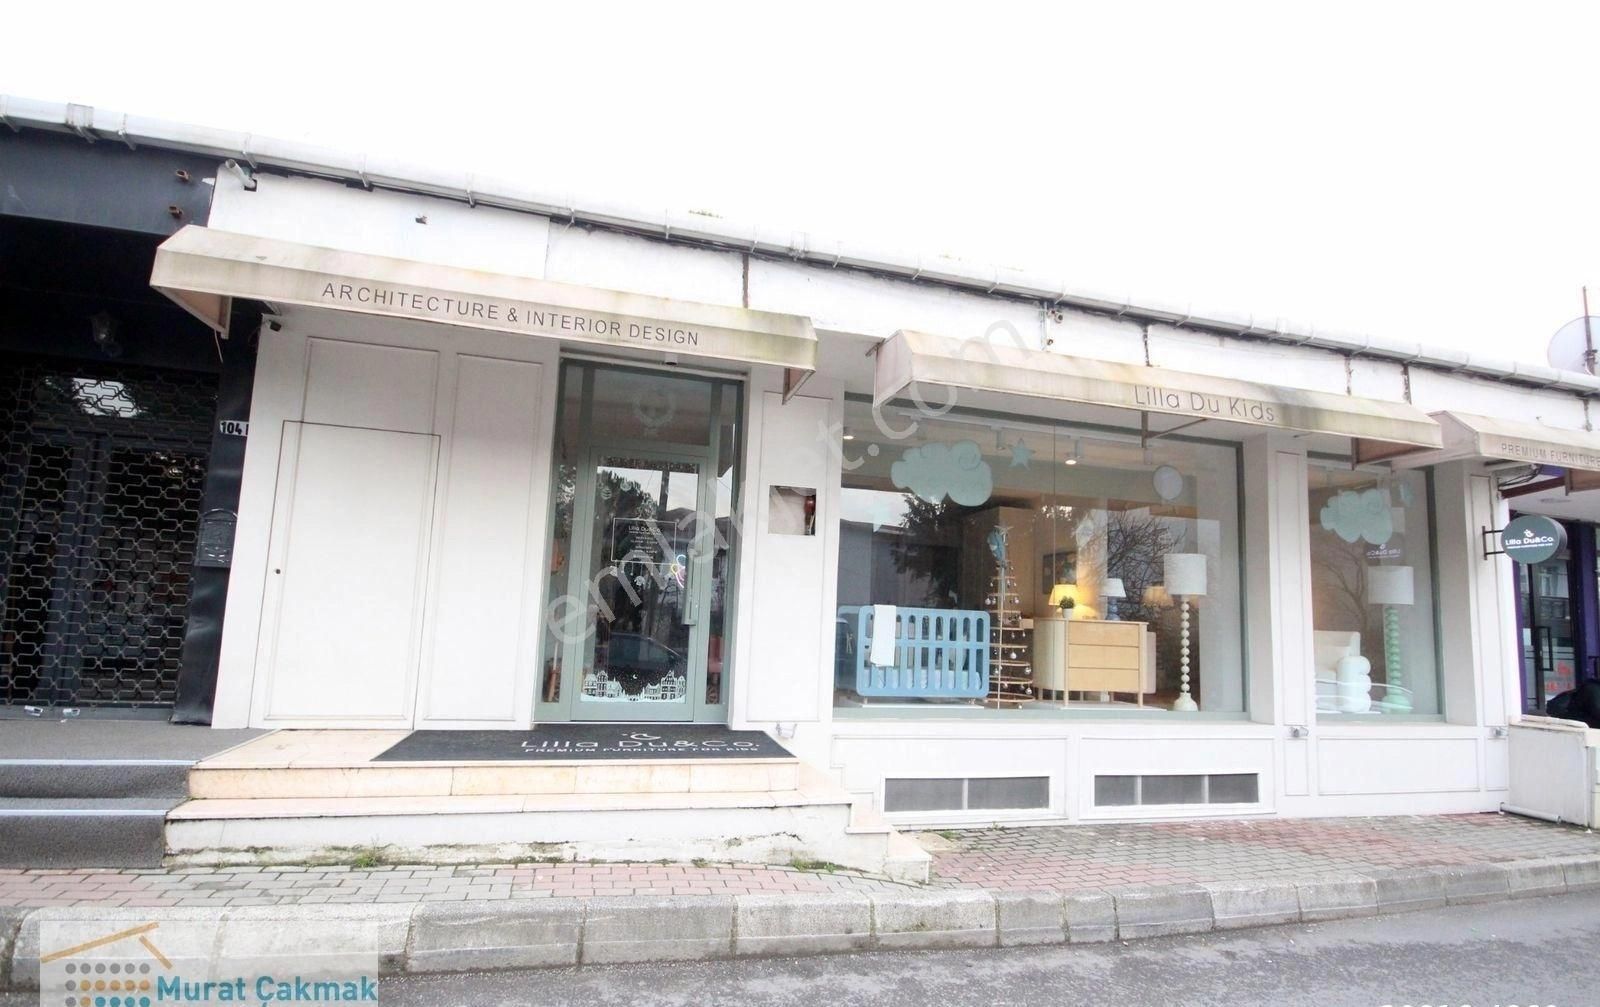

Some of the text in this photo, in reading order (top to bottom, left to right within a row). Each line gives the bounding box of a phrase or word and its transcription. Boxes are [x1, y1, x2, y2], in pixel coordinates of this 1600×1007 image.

[322, 282, 699, 346] ARCHITECTURE & INTERIOR DESIGN
[1134, 385, 1275, 422] Lilla Du Kids
[221, 421, 242, 435] 104
[1501, 442, 1546, 458] PREMIUM
[521, 740, 599, 748] Lilla
